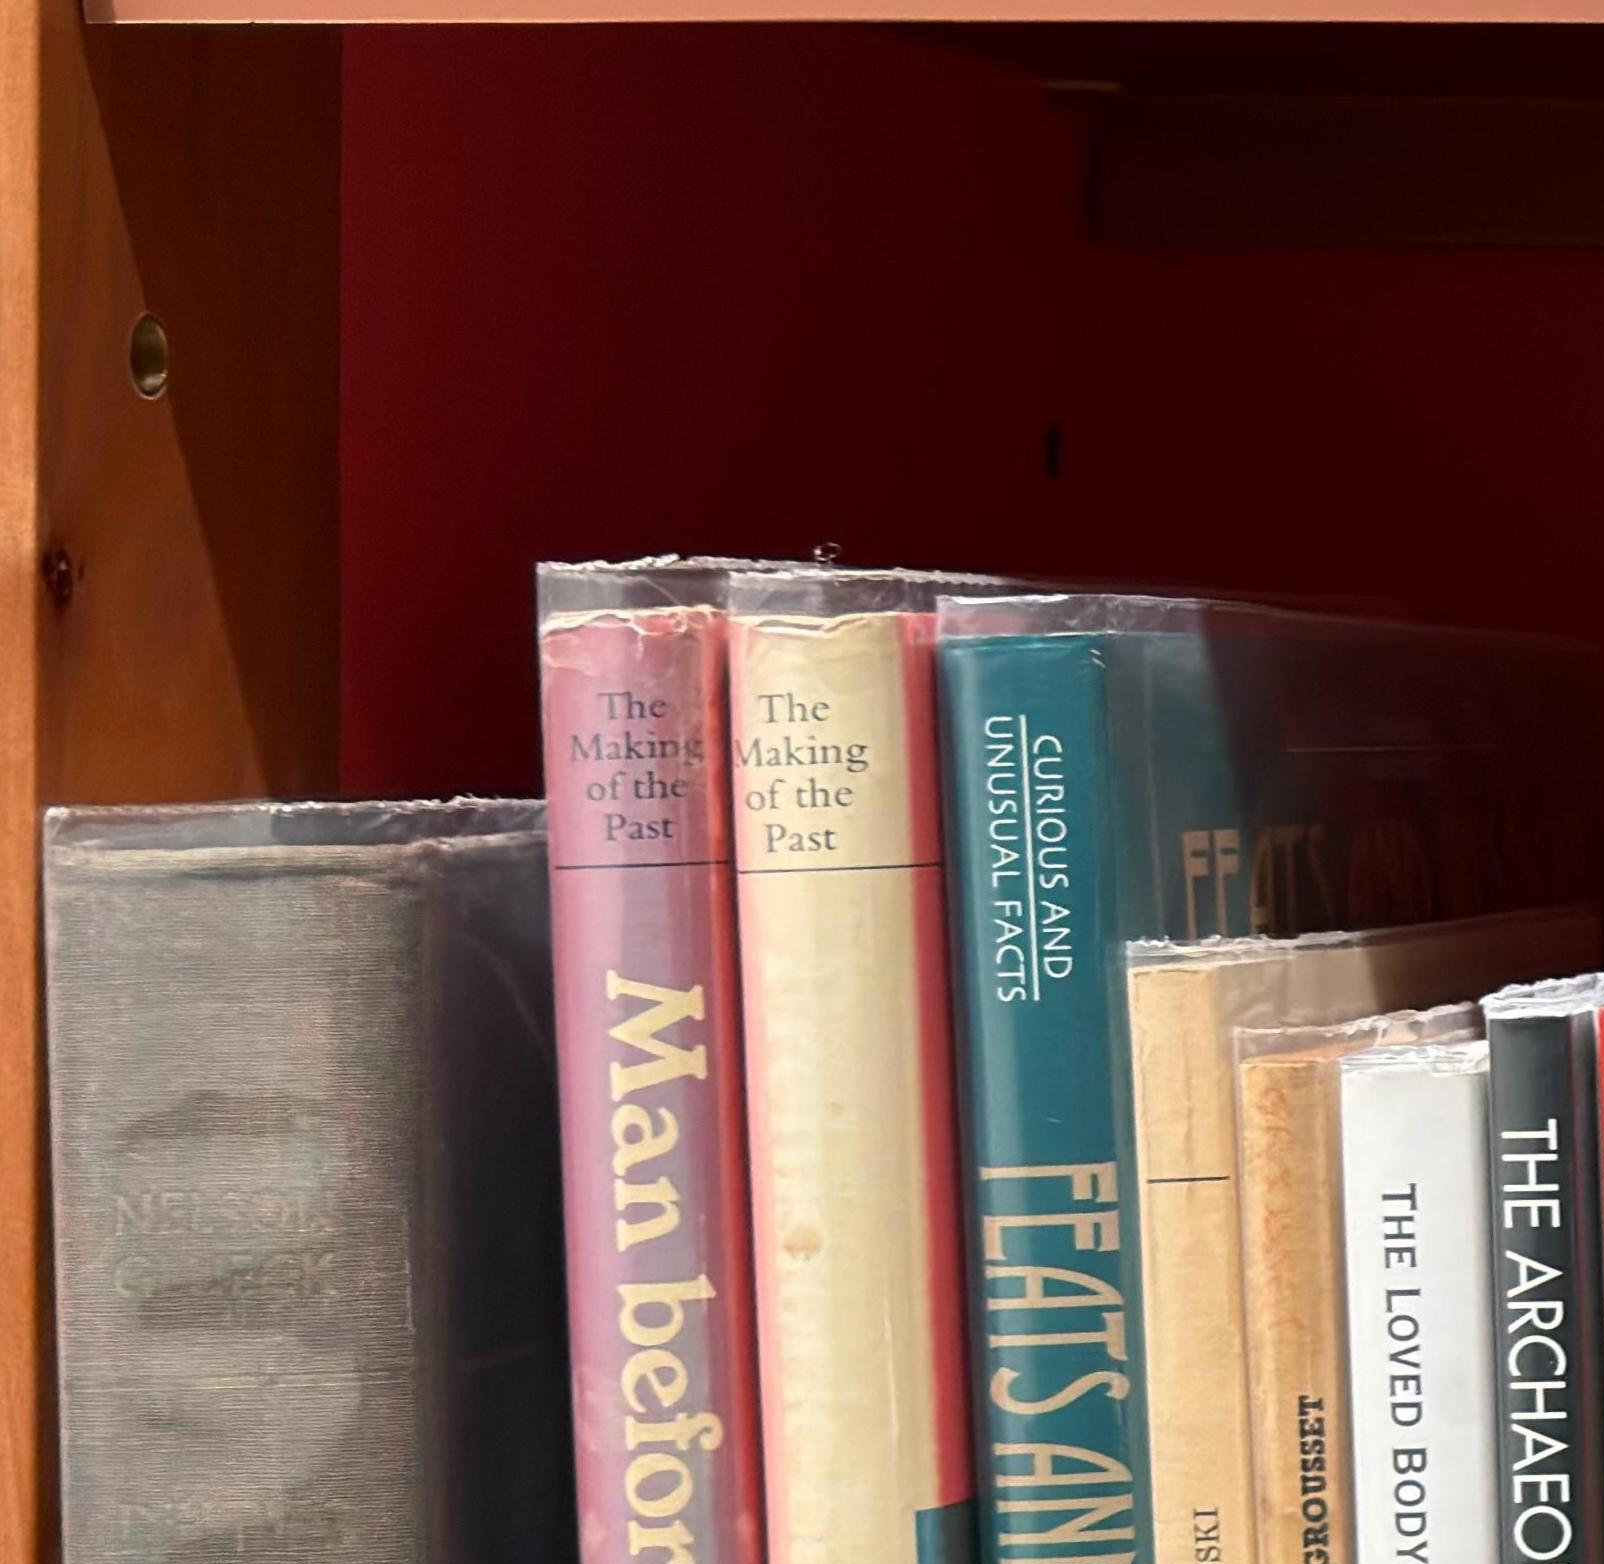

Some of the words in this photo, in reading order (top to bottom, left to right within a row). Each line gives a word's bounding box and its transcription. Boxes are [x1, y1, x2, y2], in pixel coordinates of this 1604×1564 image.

[598, 691, 666, 719] The
[758, 693, 830, 722] The
[569, 733, 705, 764] Making
[586, 771, 627, 801] of
[634, 771, 689, 799] the
[735, 736, 869, 773] Making
[605, 812, 674, 841] Past
[745, 778, 787, 811] of
[796, 778, 855, 808] the
[984, 717, 1014, 887] UNUSUAL
[1033, 735, 1070, 889] CURIOUS
[765, 823, 837, 853] Past
[994, 900, 1026, 1003] FACTS
[1041, 903, 1073, 979] AND
[605, 969, 708, 1251] Man
[1500, 1118, 1560, 1229] THE
[1381, 1183, 1419, 1269] THE
[978, 1161, 1130, 1416] FEATS
[1384, 1289, 1424, 1427] LOVED
